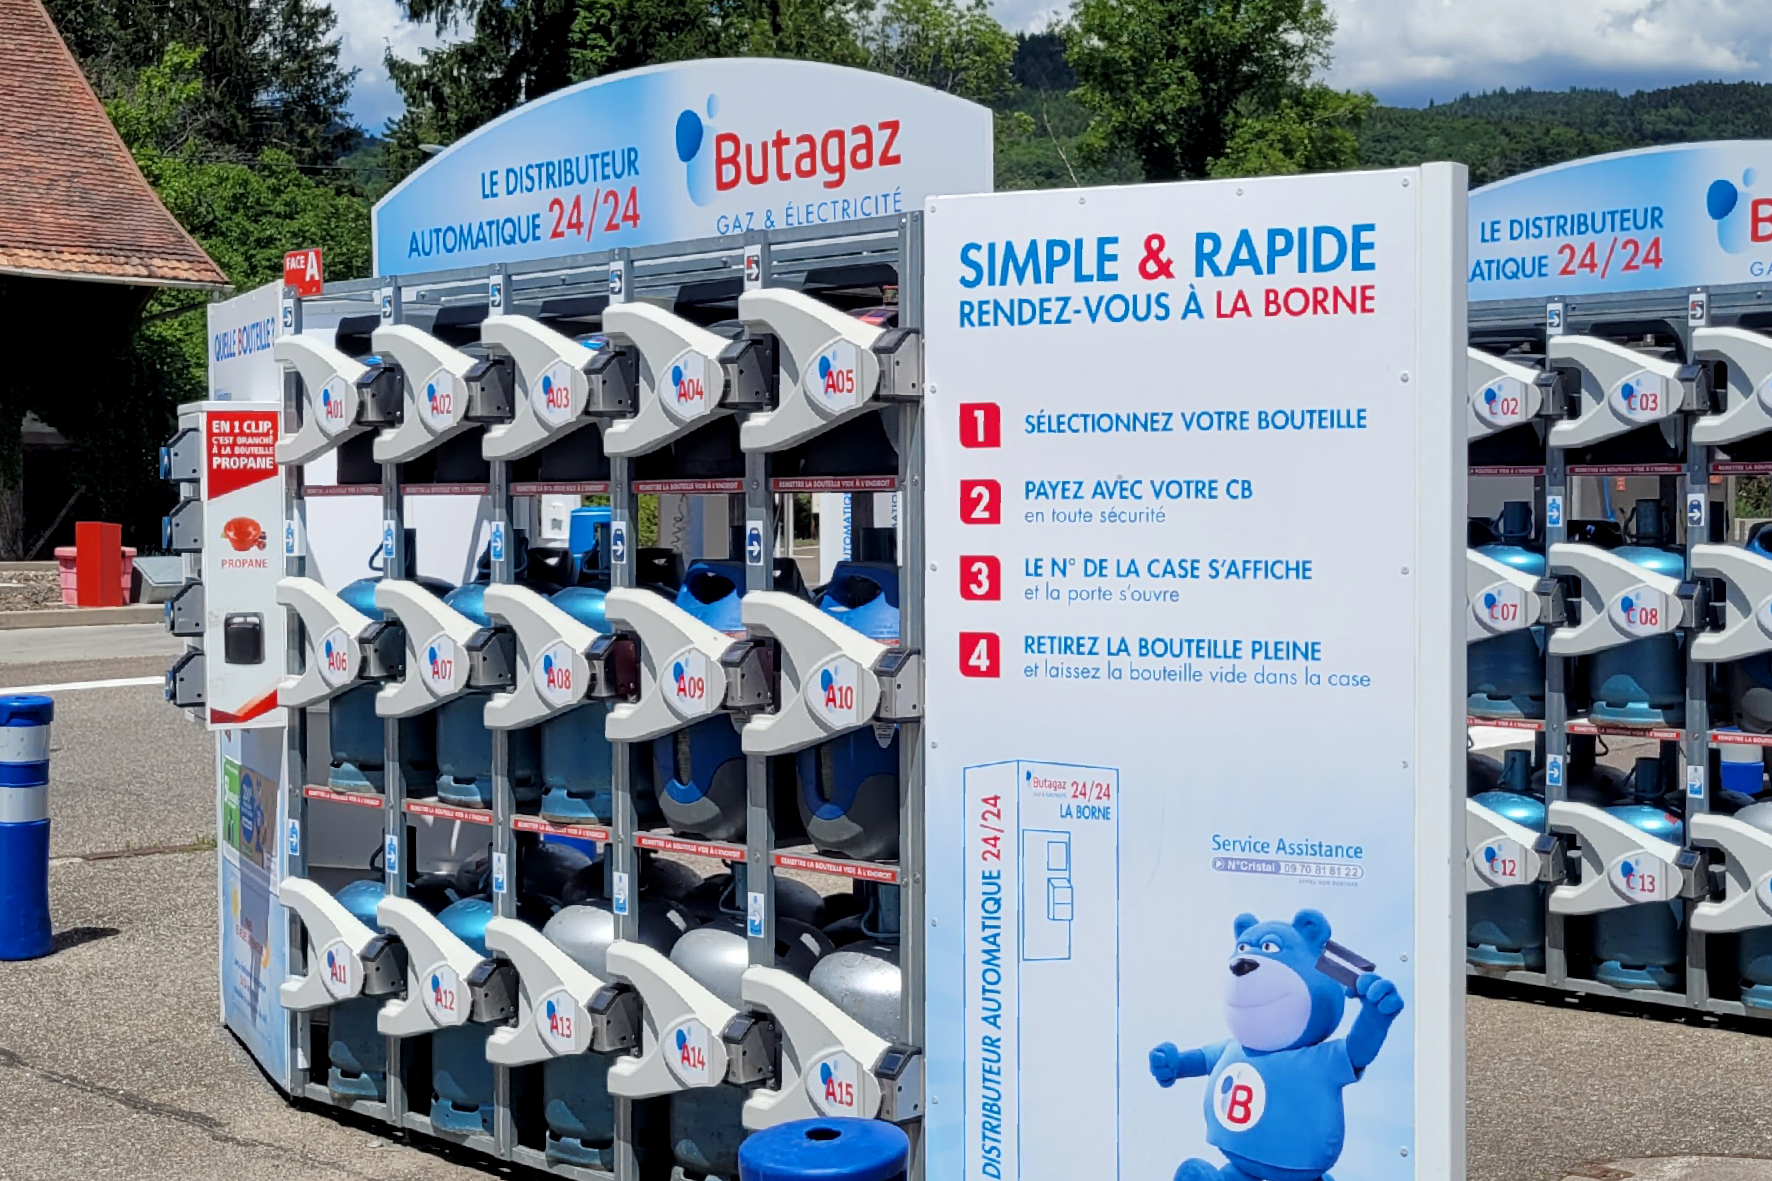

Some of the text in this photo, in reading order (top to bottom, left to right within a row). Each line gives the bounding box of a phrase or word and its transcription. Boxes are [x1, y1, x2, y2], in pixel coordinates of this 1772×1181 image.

[715, 119, 902, 192] Butagaz
[481, 146, 640, 200] LE DISTRIBUTEUR
[407, 187, 640, 259] AUTOMATIQUE 24/24
[716, 190, 903, 236] GAZ & ÉLECTRICITÉ
[1480, 206, 1664, 243] LE DISTRIBUTEUR
[286, 251, 320, 282] FACE A
[959, 223, 1377, 289] SIMPLE & RAPIDE
[1468, 236, 1663, 283] ATIQUE 24/24
[959, 282, 1376, 329] RENDEZ-VOUS À LA BORNE
[214, 329, 236, 362] QUELLE
[677, 378, 704, 402] A04
[824, 369, 855, 395] A05
[325, 400, 344, 419] A01
[431, 393, 452, 415] A02
[547, 386, 570, 409] A03
[212, 420, 273, 435] EN 1 CLIP,
[973, 406, 1367, 443] 1 SÉLECTIONNEZ VOTRE BOUTEILLE
[212, 456, 273, 470] PROPANE
[221, 445, 231, 454] LA
[234, 446, 274, 455] BOUTEILLE
[970, 479, 1253, 519] 2 PAYEZ AVEC VOTRE CB
[1024, 506, 1166, 524] en toute sécurité
[221, 558, 268, 568] PROPANE
[969, 558, 1313, 596] 3 LE N° DE LA CASE S'AFFICHE
[1024, 583, 1180, 607] et la porte s'ouvre
[328, 650, 347, 672] A06
[968, 635, 1322, 671] 4 RETIREZ LA BOUTEILLE PLEINE
[431, 658, 453, 681] A07
[546, 666, 572, 691] A08
[1024, 661, 1371, 689] et laissez la bouteille vide dans la case
[676, 674, 705, 700] A09
[825, 683, 854, 710] A10
[1033, 777, 1111, 803] Butagaz 24/24
[1060, 803, 1111, 821] LA BORNE
[1212, 834, 1363, 858] Service Assistance
[807, 860, 814, 868] LA
[1284, 863, 1297, 873] 09
[1300, 864, 1311, 874] 70
[1315, 865, 1326, 875] 81
[1329, 866, 1341, 876] 81
[1345, 867, 1358, 877] 22
[331, 964, 347, 985] A11
[980, 795, 1004, 1180] 24/24 AUTOMATIQUE DISTRIBUTEUR
[434, 988, 455, 1011] A12
[550, 1013, 573, 1038] A13
[680, 1043, 706, 1071] A14
[825, 1077, 854, 1107] A15
[1226, 1084, 1253, 1124] B
